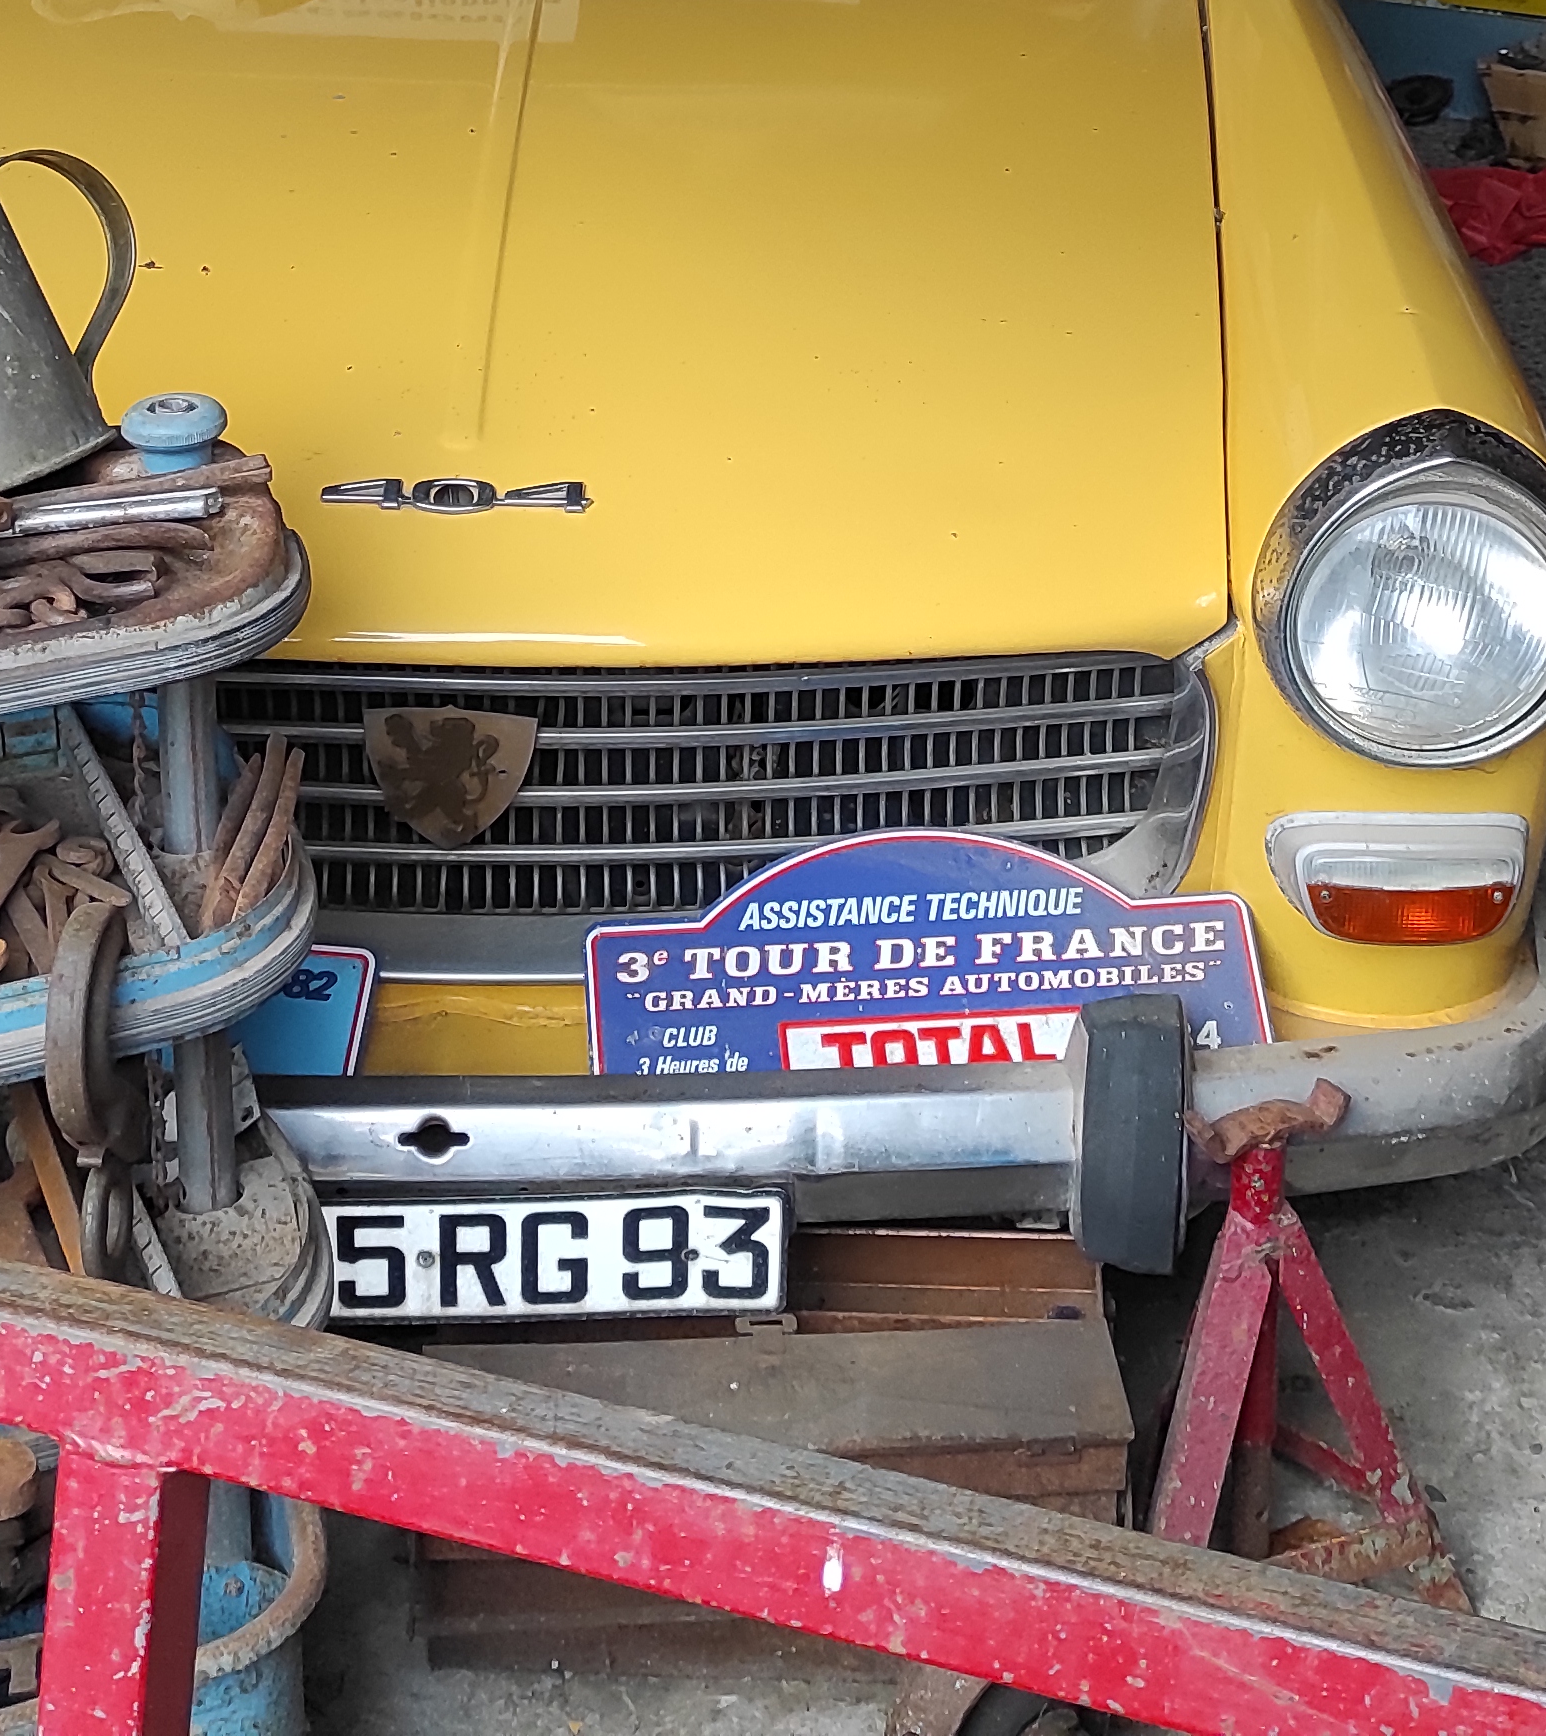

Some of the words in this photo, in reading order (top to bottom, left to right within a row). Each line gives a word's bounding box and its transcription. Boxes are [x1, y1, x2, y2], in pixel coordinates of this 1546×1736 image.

[321, 477, 593, 515] 404
[738, 893, 918, 931] ASSISTANCE
[926, 887, 1084, 921] TECHNIQUE
[683, 941, 854, 981] TOUR
[873, 935, 957, 970] DE
[974, 920, 1226, 966] FRANCE
[282, 968, 338, 1002] 82
[663, 1025, 717, 1048] CLUB
[821, 1022, 1057, 1069] TOTAL
[656, 1055, 719, 1075] Heures
[726, 1051, 749, 1073] de
[441, 1211, 587, 1308] RG
[623, 1205, 769, 1302] 93
